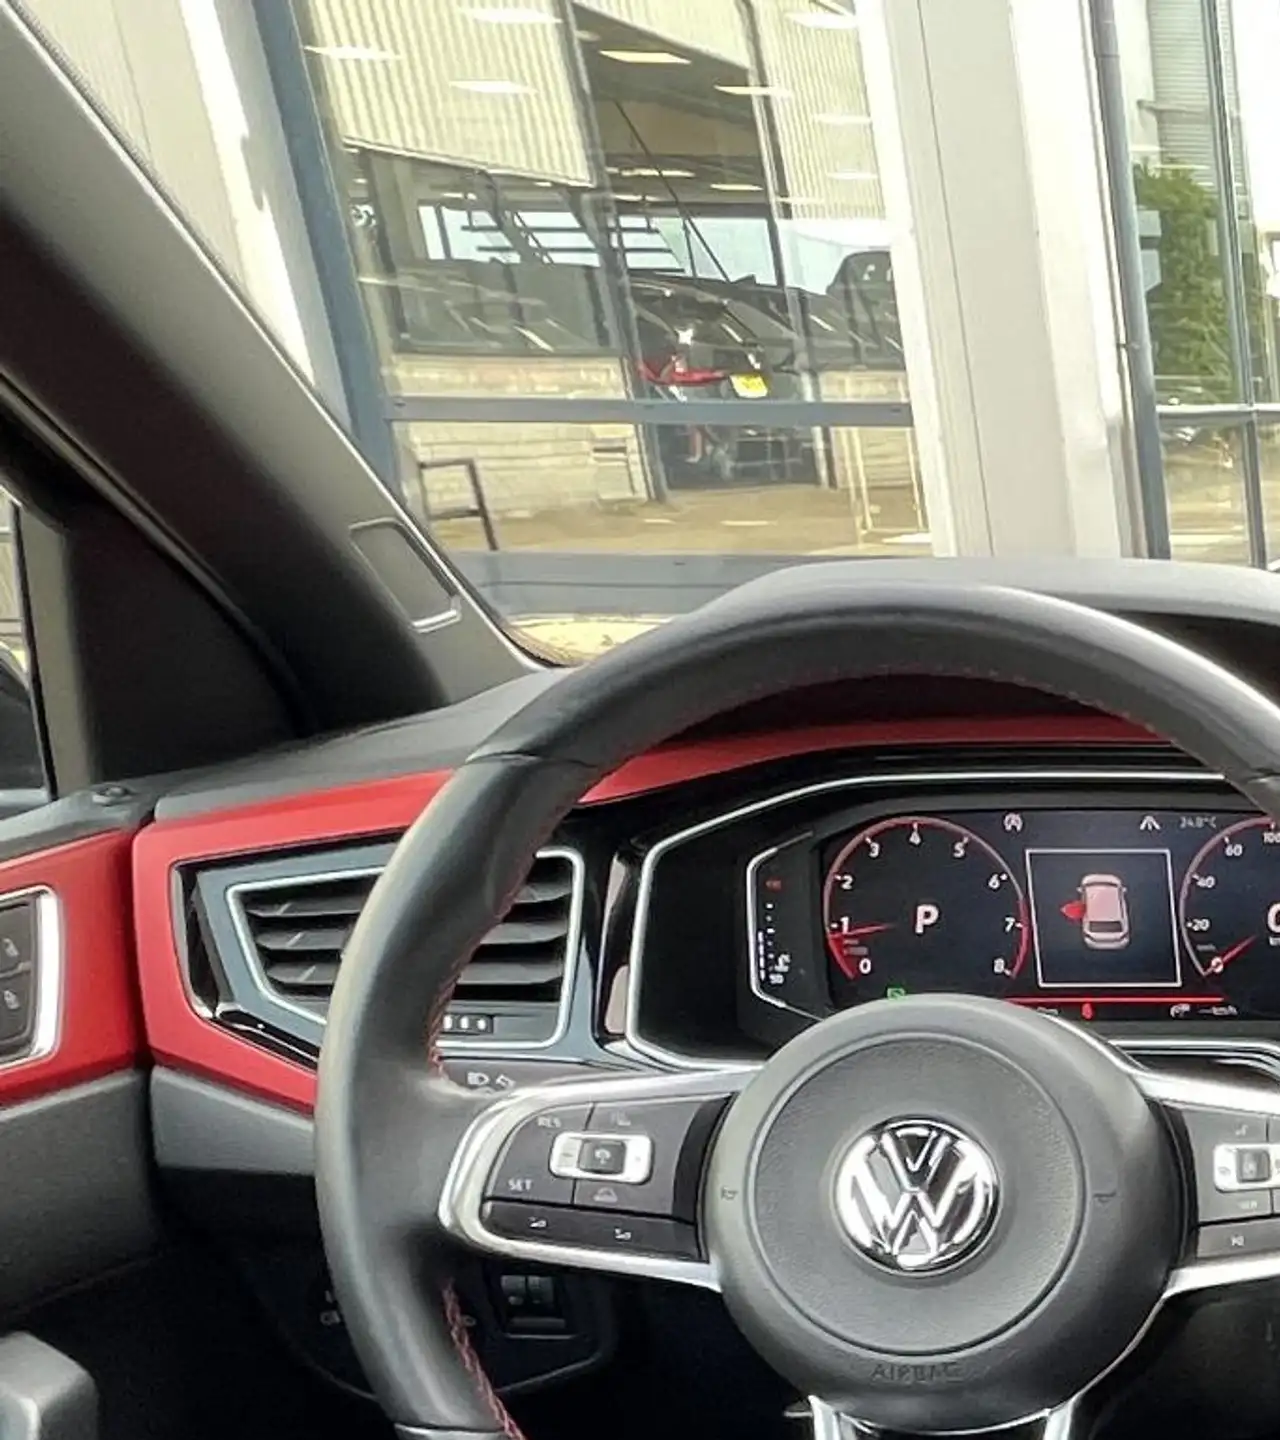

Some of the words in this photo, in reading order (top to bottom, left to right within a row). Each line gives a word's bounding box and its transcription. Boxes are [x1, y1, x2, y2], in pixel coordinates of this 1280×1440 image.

[909, 831, 921, 845] 4
[869, 842, 880, 858] 3
[953, 842, 966, 858] 5
[841, 875, 853, 889] 2
[988, 874, 1000, 889] 6
[915, 904, 939, 934] P
[1004, 917, 1015, 932] 7
[858, 958, 871, 974] 0
[993, 958, 1005, 974] 8
[507, 1178, 533, 1192] SET
